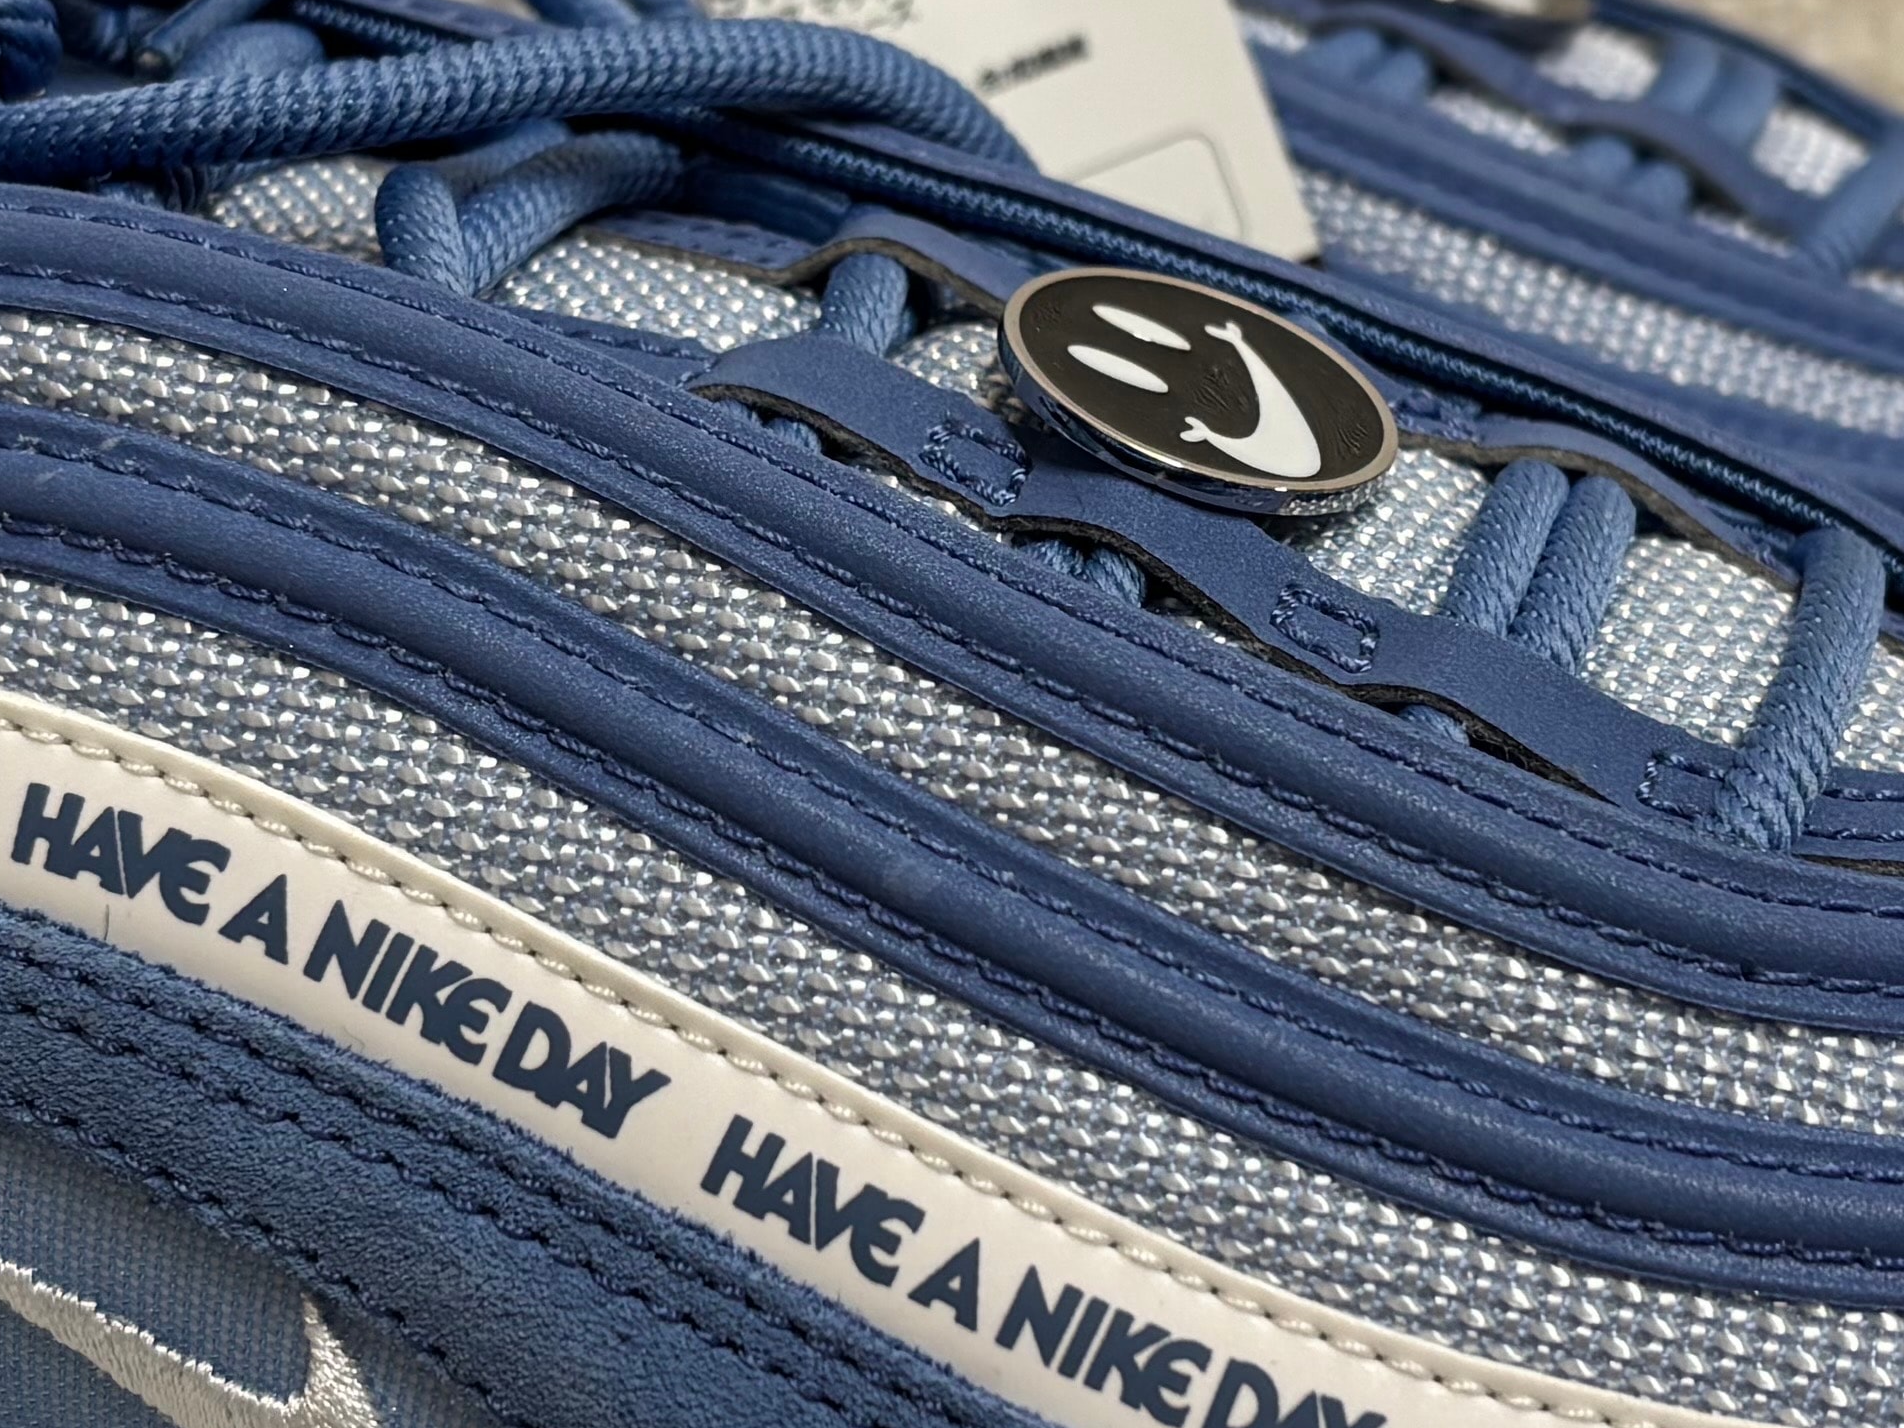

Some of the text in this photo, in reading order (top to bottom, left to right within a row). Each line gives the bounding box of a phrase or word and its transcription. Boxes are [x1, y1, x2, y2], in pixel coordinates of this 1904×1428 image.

[11, 782, 672, 1139] HAVE A NIKE DAY
[700, 1113, 926, 1288] HAVE
[908, 1237, 981, 1332] A
[995, 1264, 1213, 1428] NIKE
